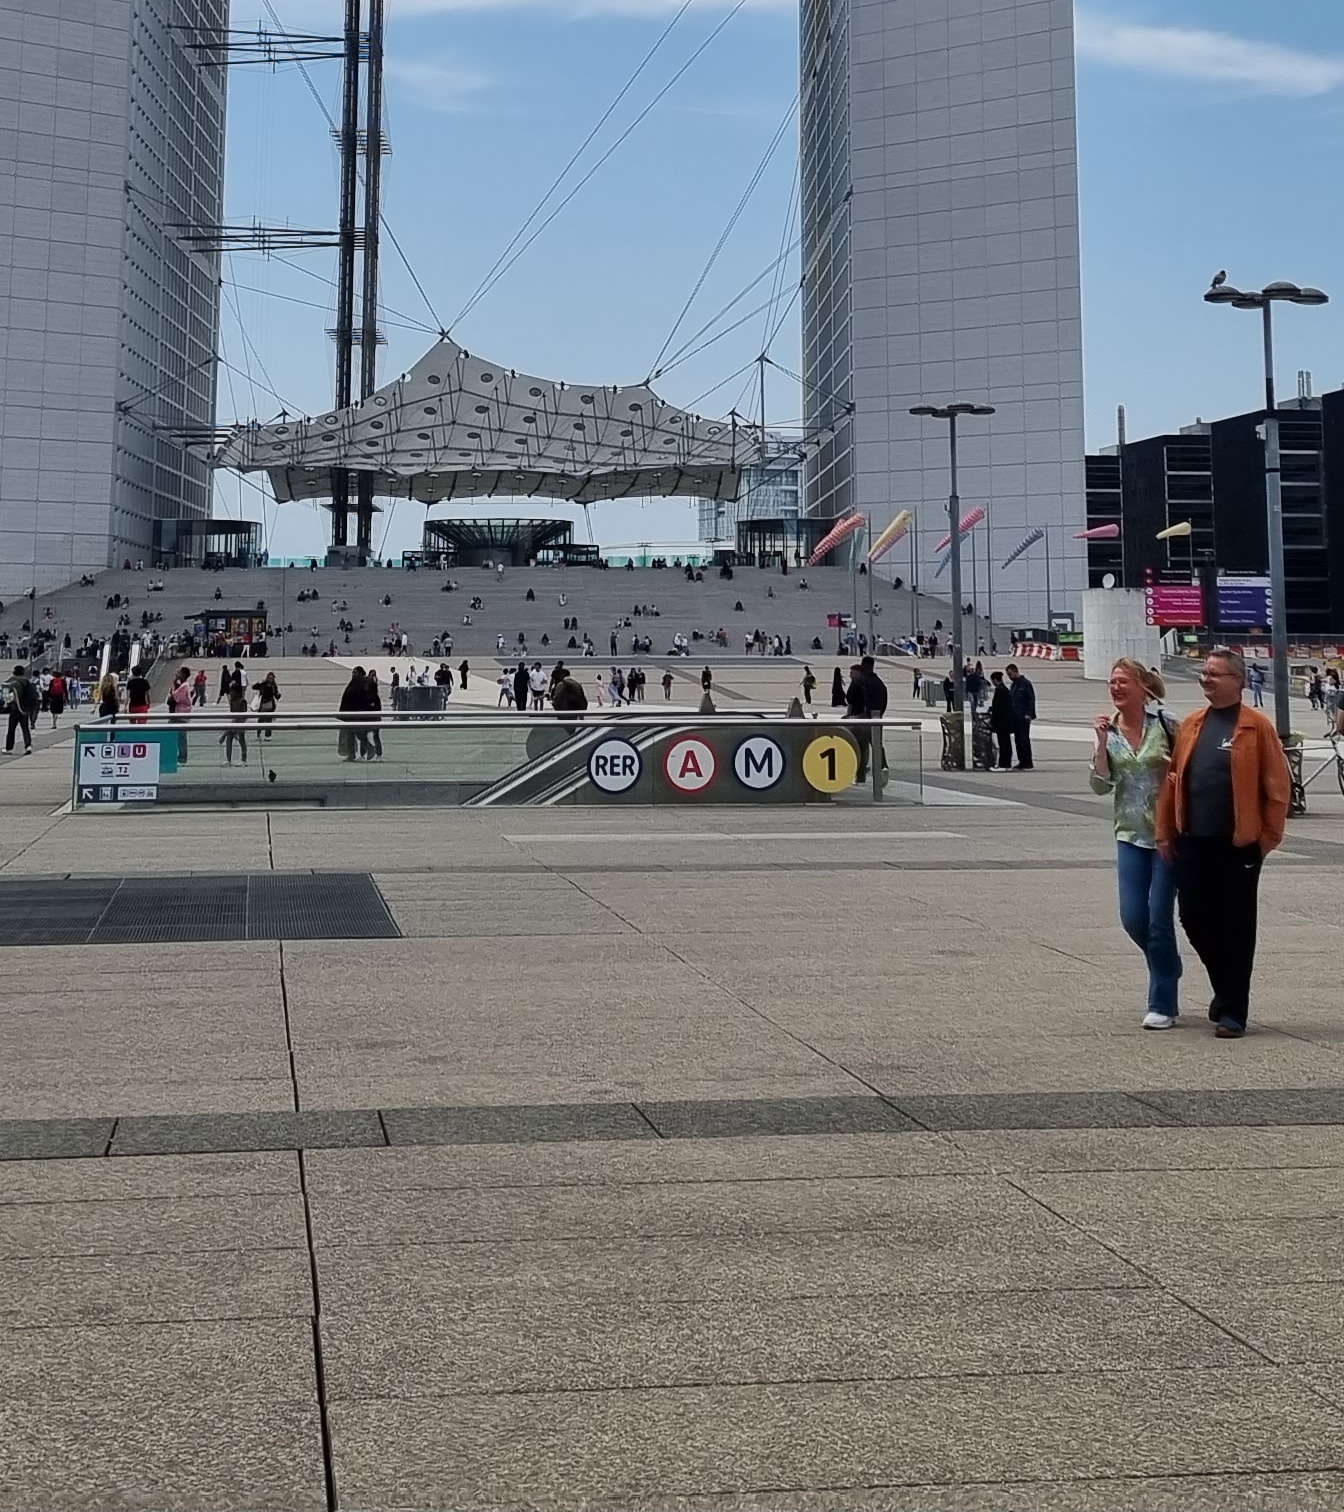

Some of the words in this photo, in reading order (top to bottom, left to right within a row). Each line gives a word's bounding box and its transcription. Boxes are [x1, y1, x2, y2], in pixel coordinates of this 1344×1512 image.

[118, 766, 128, 774] T2
[595, 755, 635, 777] RER
[678, 750, 703, 778] A
[744, 747, 773, 778] M
[819, 747, 836, 781] 1
